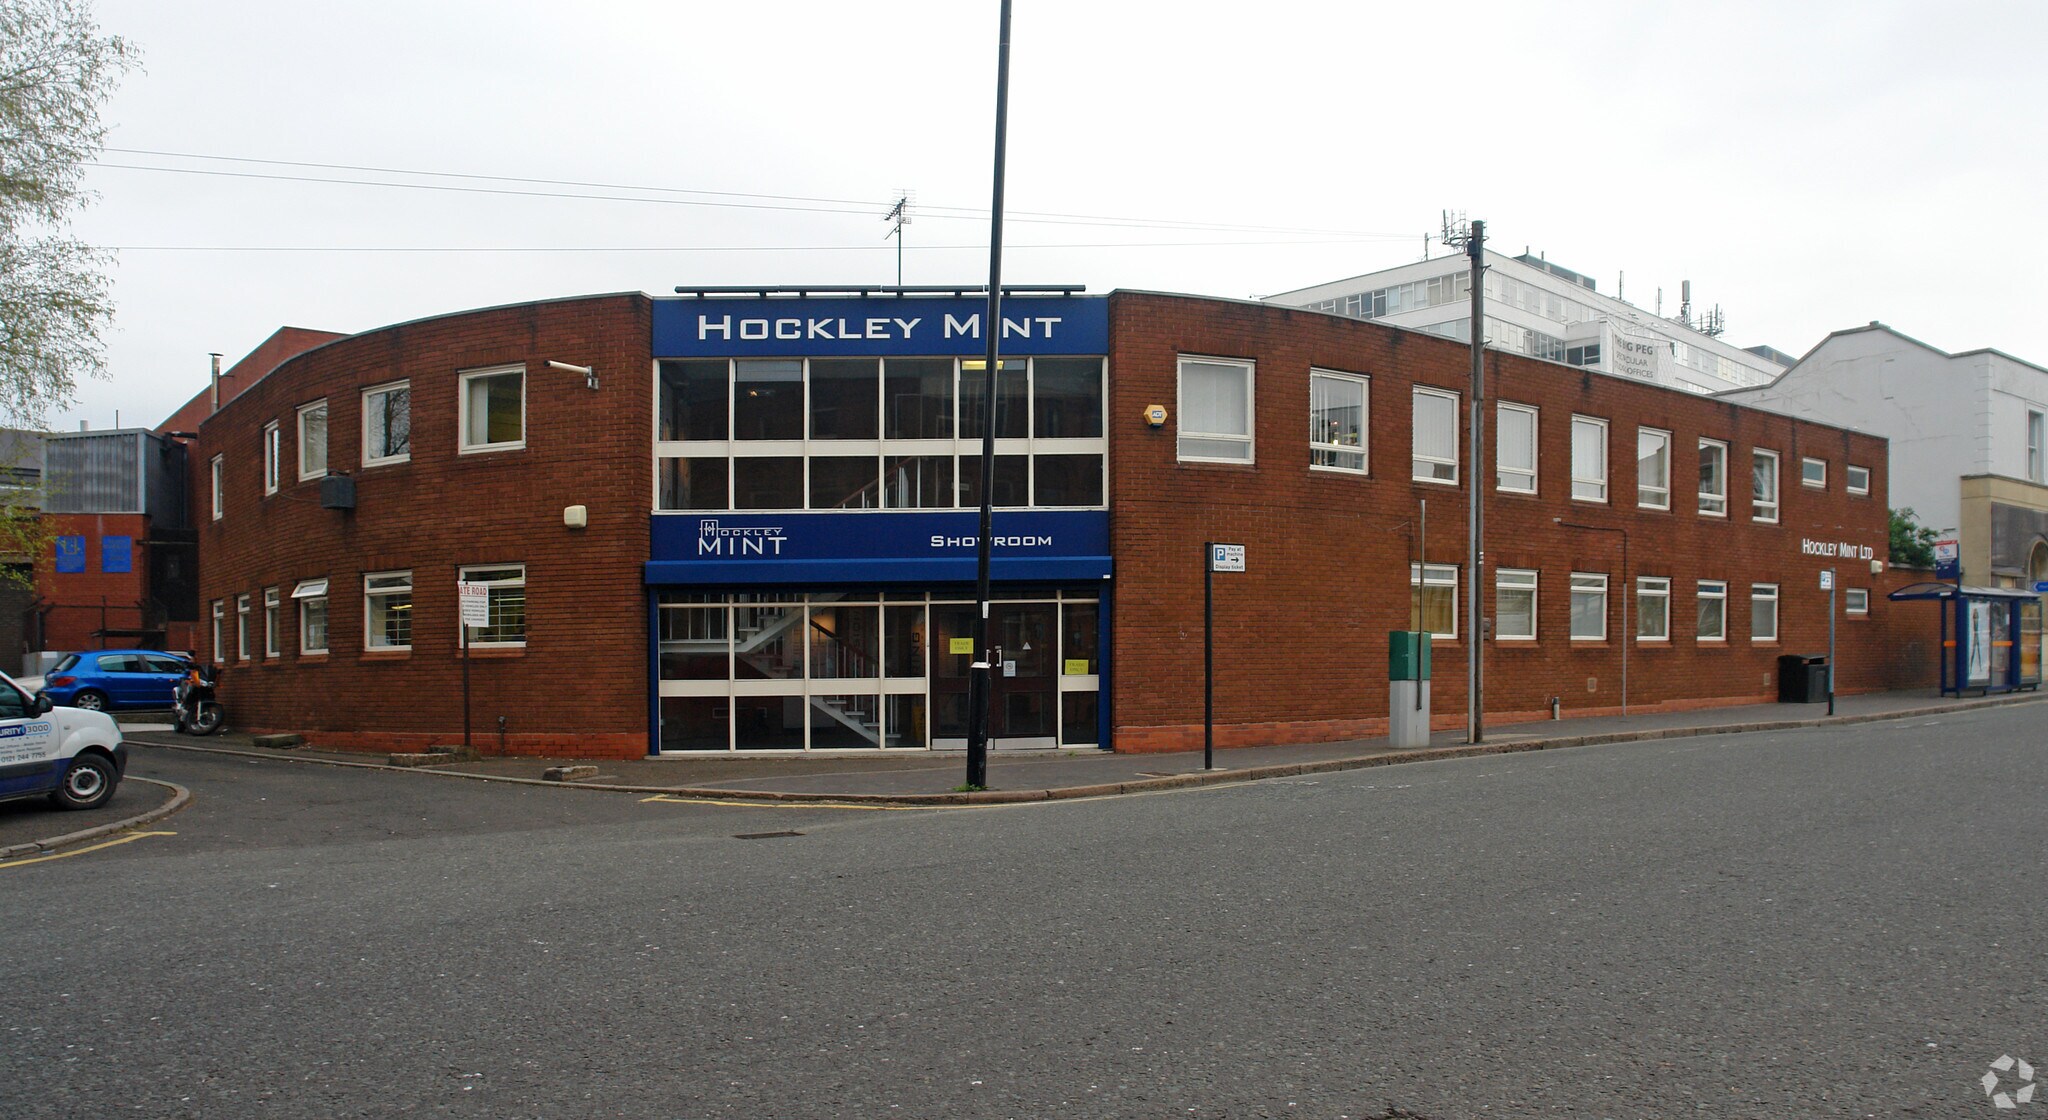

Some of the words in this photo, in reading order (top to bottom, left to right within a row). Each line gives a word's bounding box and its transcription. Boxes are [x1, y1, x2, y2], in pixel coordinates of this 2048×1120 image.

[698, 315, 921, 340] HOCKLEY
[944, 314, 1061, 339] MNT
[1636, 344, 1653, 355] PEG
[699, 537, 787, 555] MINT
[931, 535, 1051, 547] SHOROOM
[1803, 538, 1837, 556] HOCKLEY
[1840, 542, 1857, 558] MINT
[1860, 544, 1873, 559] LTD
[471, 587, 487, 596] ROAD
[27, 724, 48, 733] 3000
